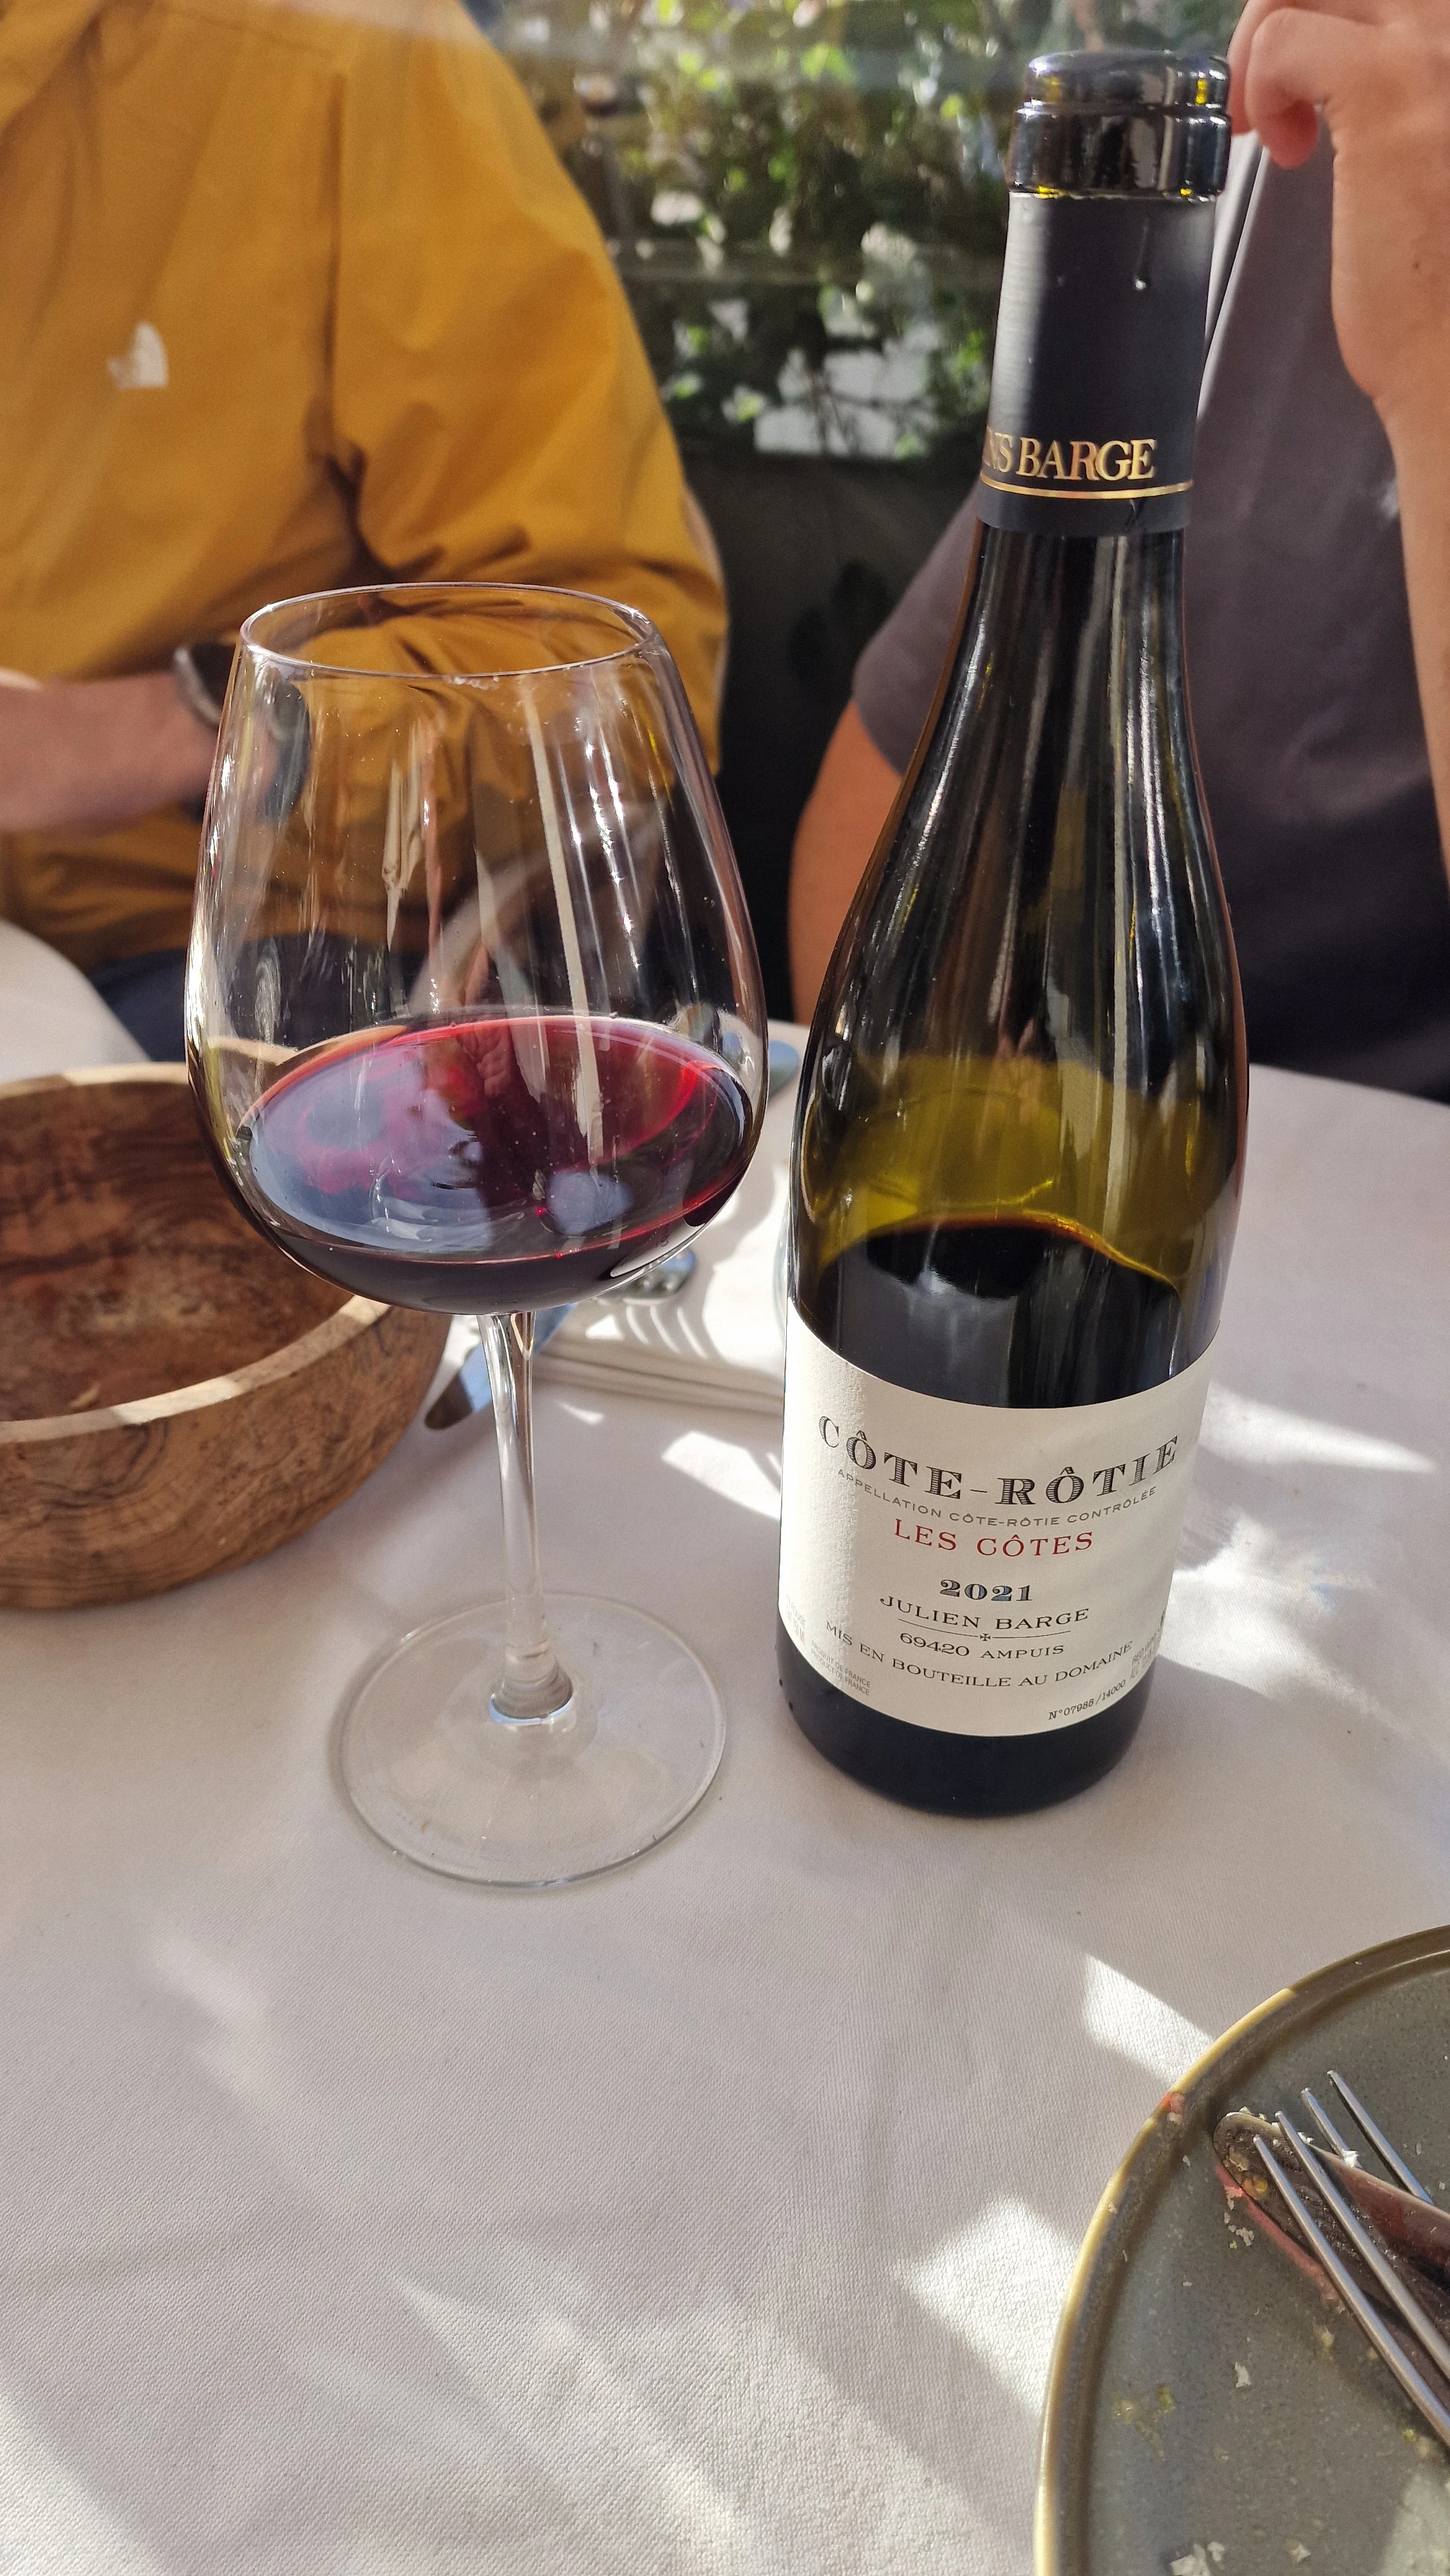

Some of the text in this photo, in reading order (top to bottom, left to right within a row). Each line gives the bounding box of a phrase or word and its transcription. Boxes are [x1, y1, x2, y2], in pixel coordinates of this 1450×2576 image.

[1016, 438, 1158, 481] BARGE
[838, 1468, 1156, 1527] APPELLATION CÔTE-RÔTIE CONTRÔLÉE
[894, 1518, 1093, 1557] LES CÔTES
[939, 1579, 1033, 1602] 2021
[880, 1596, 1089, 1630] JULIEN BARGE
[826, 1620, 853, 1646] MIS
[860, 1642, 885, 1663] EN
[892, 1658, 1011, 1687] BOUTEILLE
[1017, 1674, 1048, 1686] AU
[1054, 1640, 1133, 1682] DOMAINE
[899, 1633, 1064, 1659] 69420 AMPUIS
[844, 1677, 870, 1696] FRANCE
[845, 1669, 871, 1689] FRANCE
